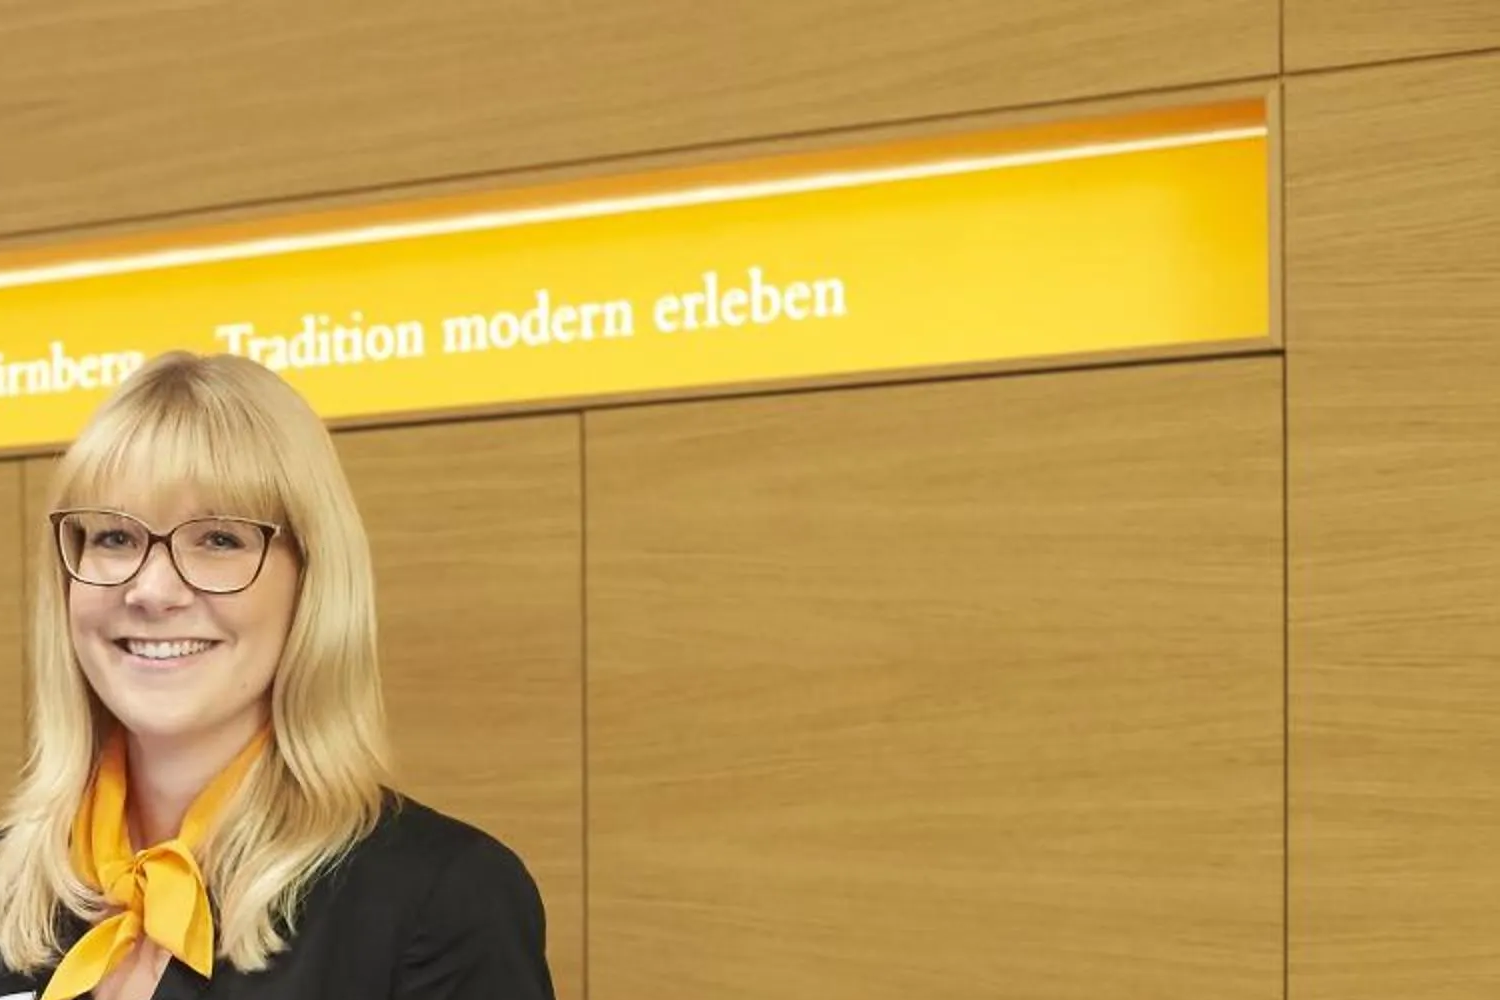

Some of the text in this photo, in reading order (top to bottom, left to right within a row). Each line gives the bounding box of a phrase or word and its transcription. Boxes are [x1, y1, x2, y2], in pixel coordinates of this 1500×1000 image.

[215, 313, 424, 371] Tradition
[443, 289, 634, 353] modern
[653, 266, 846, 333] erleben
